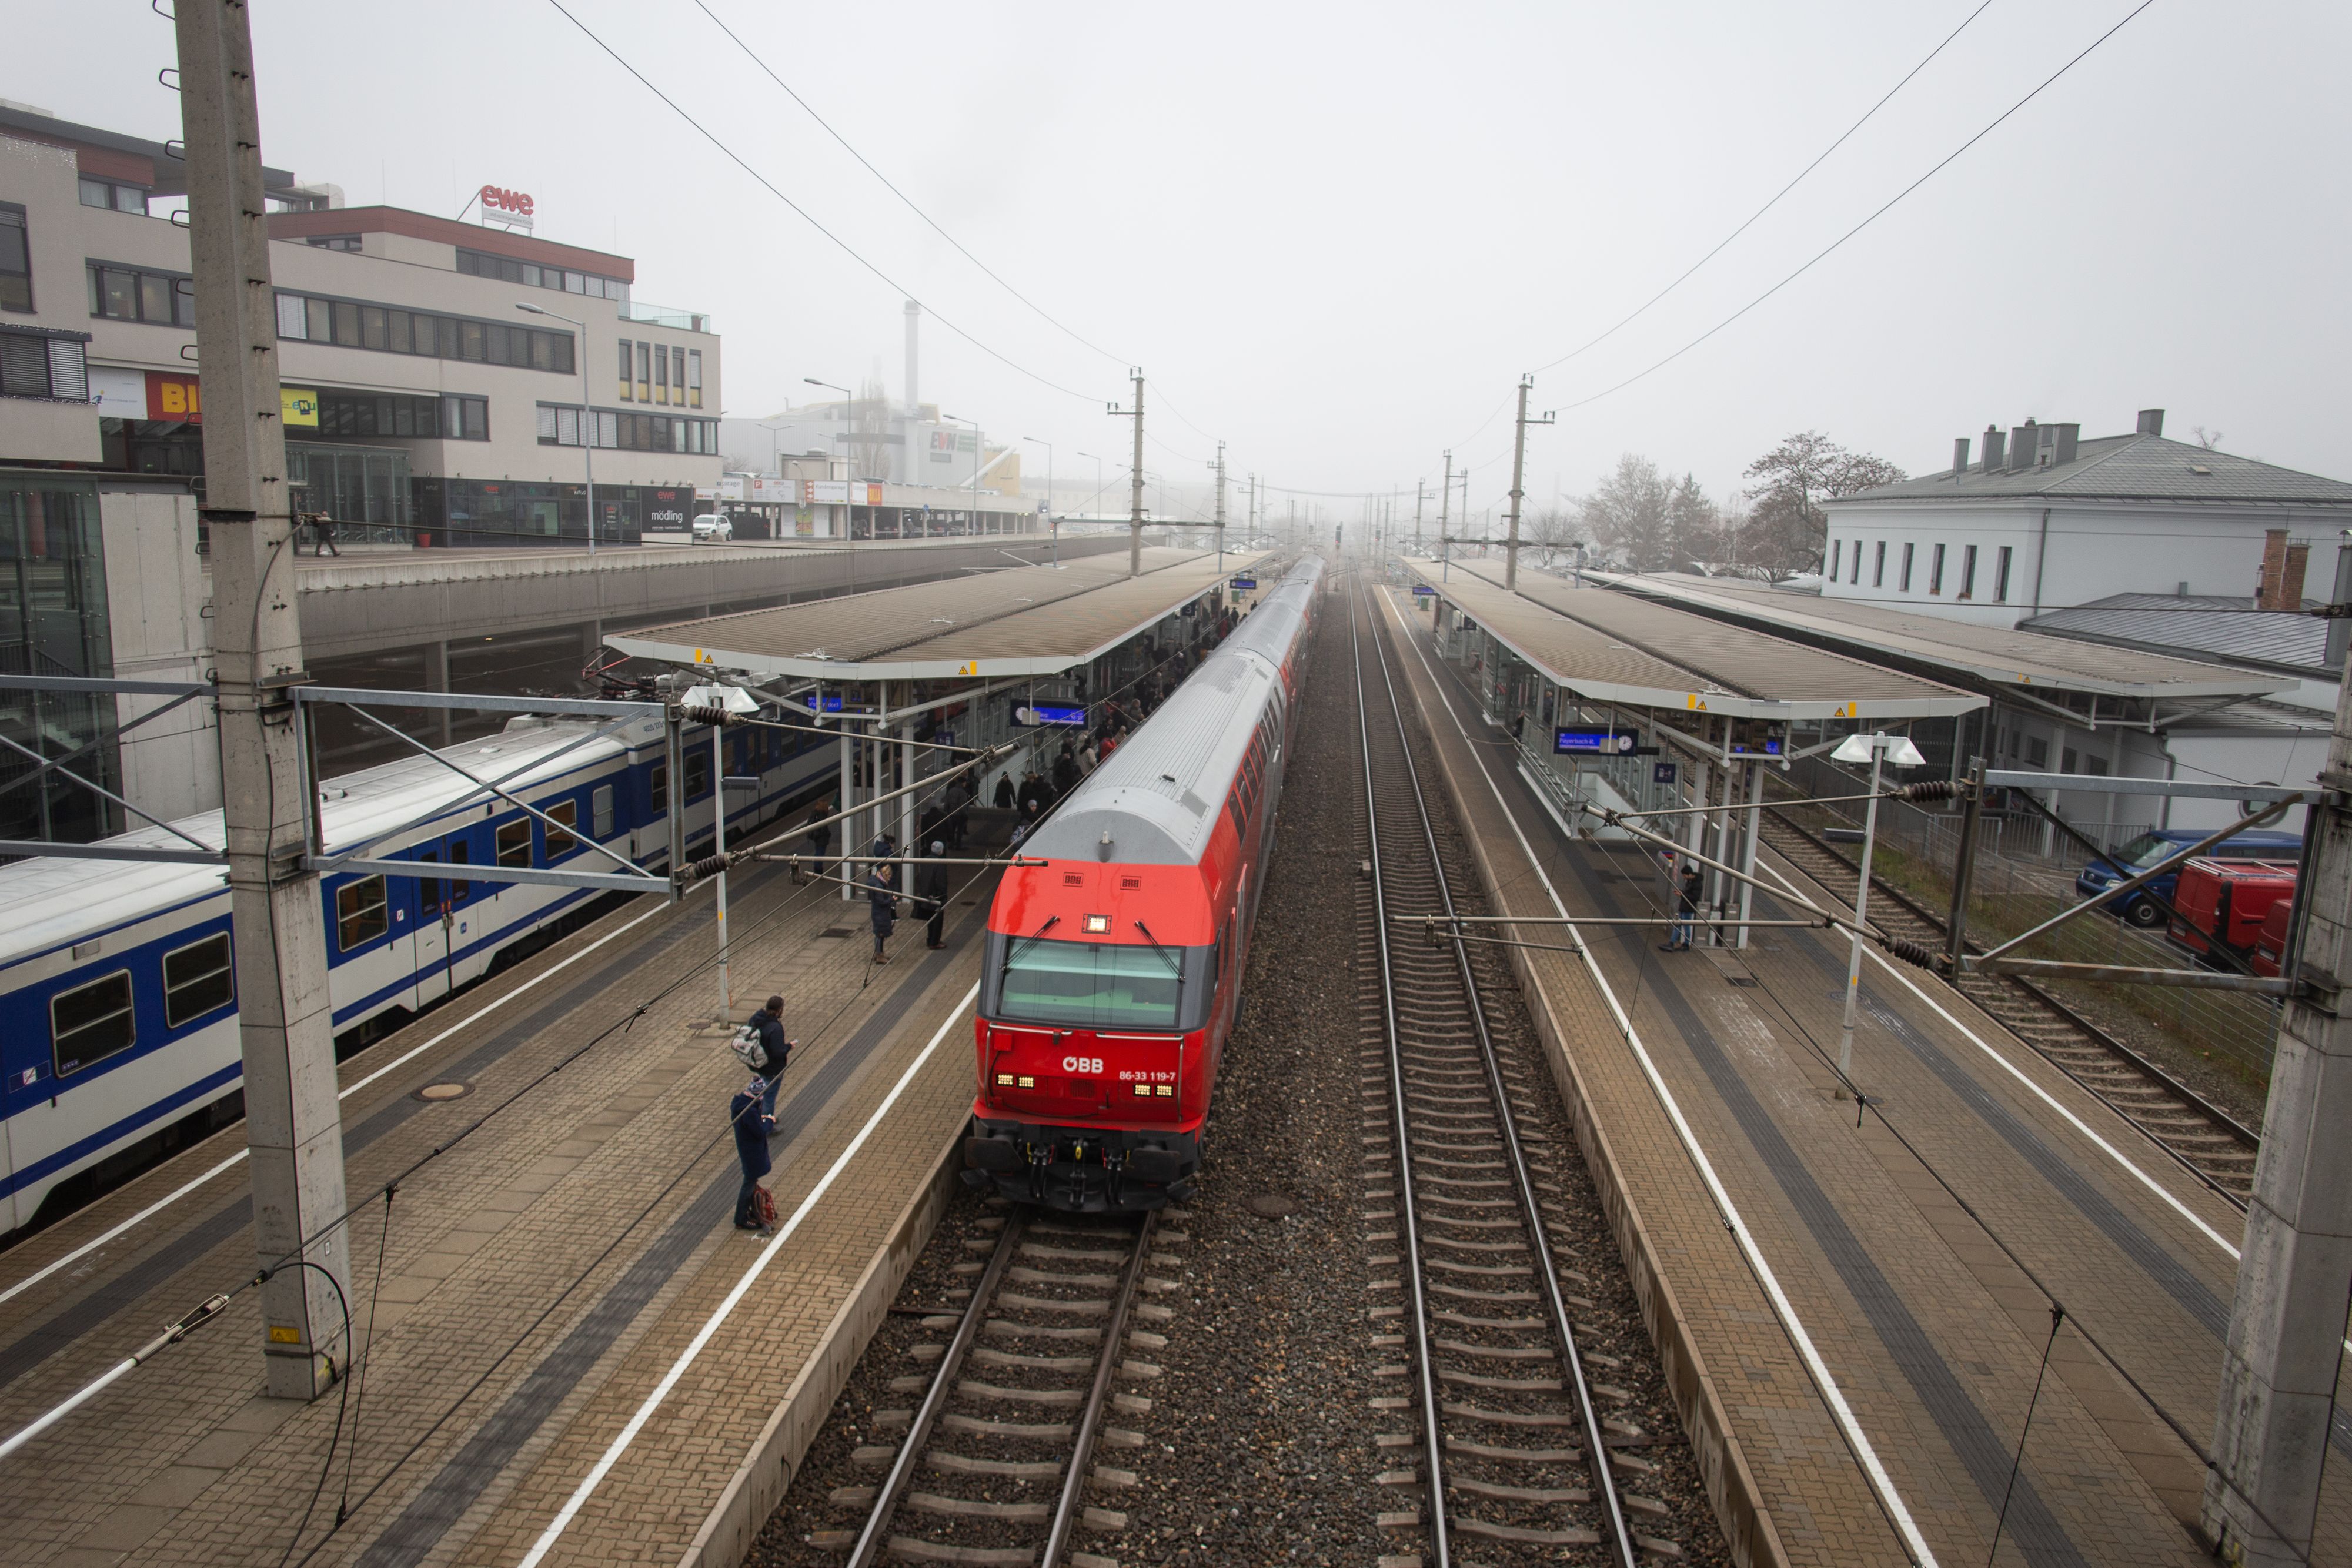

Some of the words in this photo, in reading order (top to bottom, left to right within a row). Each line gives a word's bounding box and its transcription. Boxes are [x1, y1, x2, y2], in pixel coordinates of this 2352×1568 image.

[481, 185, 533, 215] ewe
[161, 383, 201, 413] BI
[930, 431, 957, 450] EVN
[652, 510, 682, 523] mödling
[1185, 605, 1192, 613] 3
[1467, 619, 1474, 628] 2
[1063, 1057, 1104, 1074] ÖBB
[1119, 1071, 1147, 1080] 86-33
[1150, 1072, 1175, 1081] 119-7
